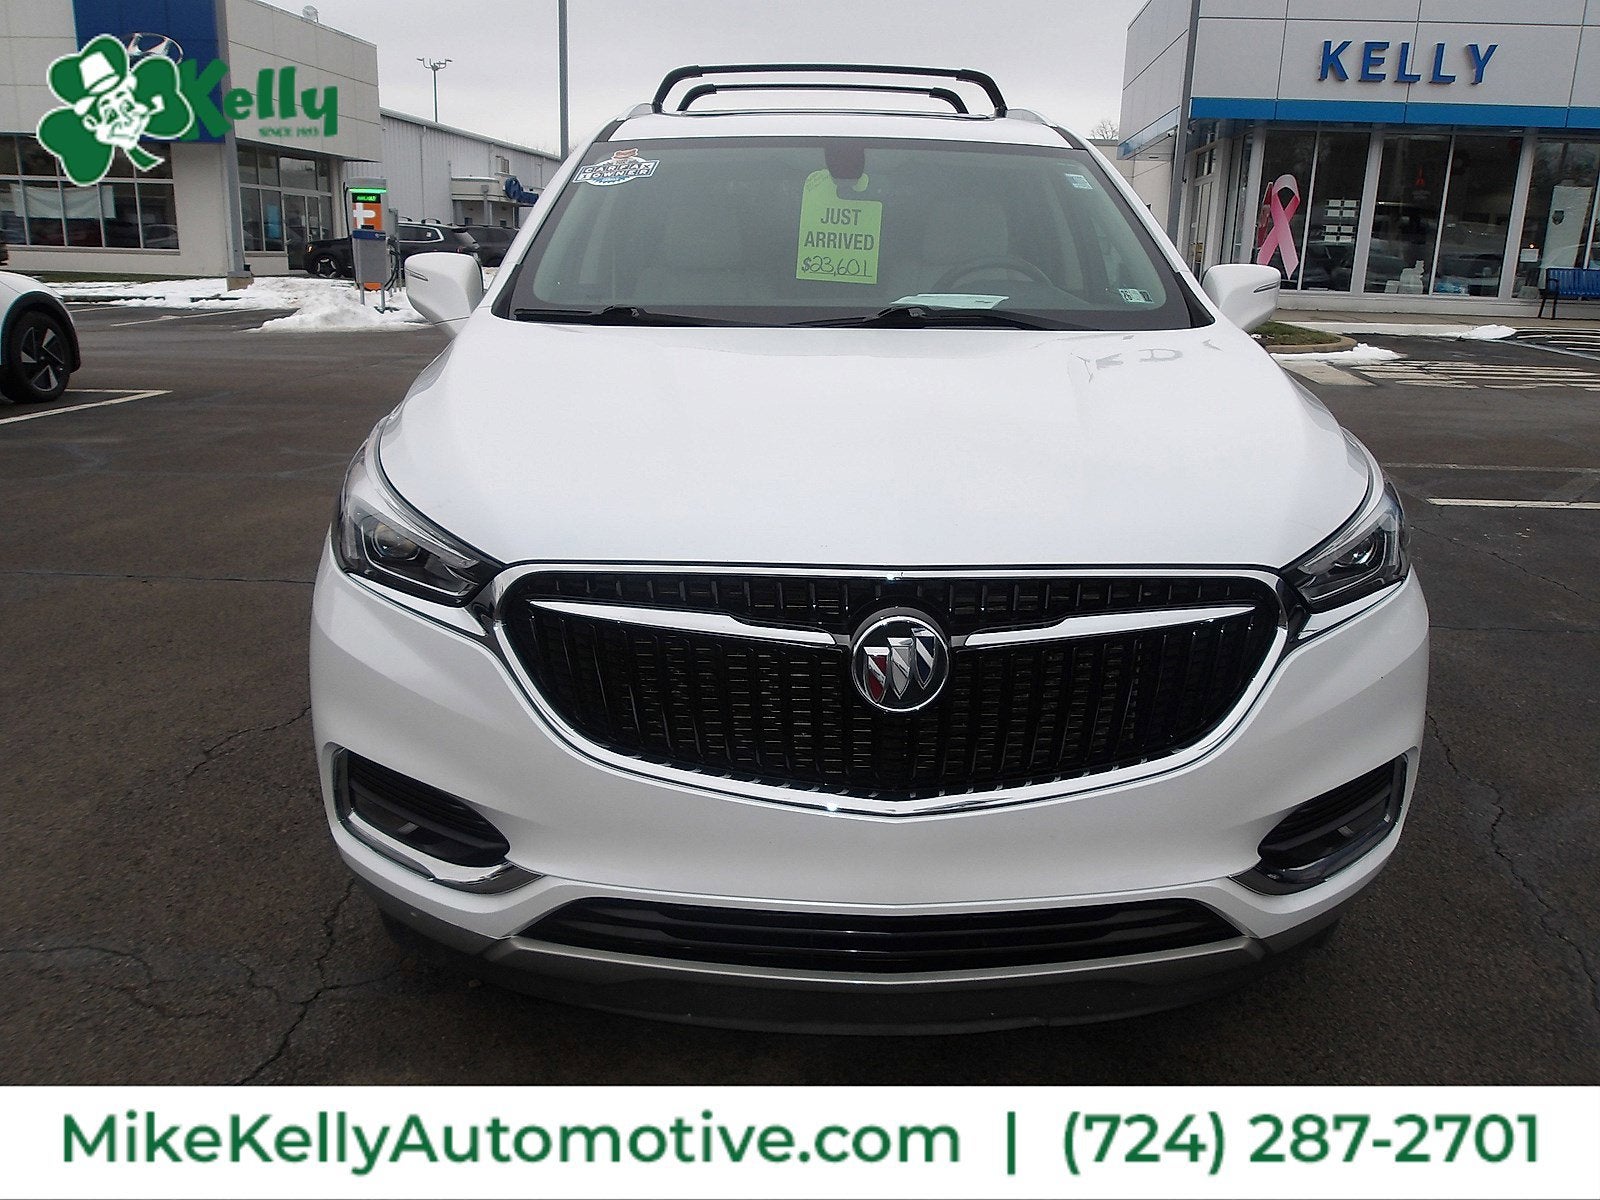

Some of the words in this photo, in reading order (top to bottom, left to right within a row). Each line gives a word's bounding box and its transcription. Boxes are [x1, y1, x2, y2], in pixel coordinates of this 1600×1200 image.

[1317, 39, 1499, 85] KELLY
[584, 161, 655, 173] CARFAX
[592, 168, 649, 178] OWNER
[820, 207, 862, 226] JUST
[803, 230, 876, 251] ARRIVED
[801, 255, 868, 276] $23,601
